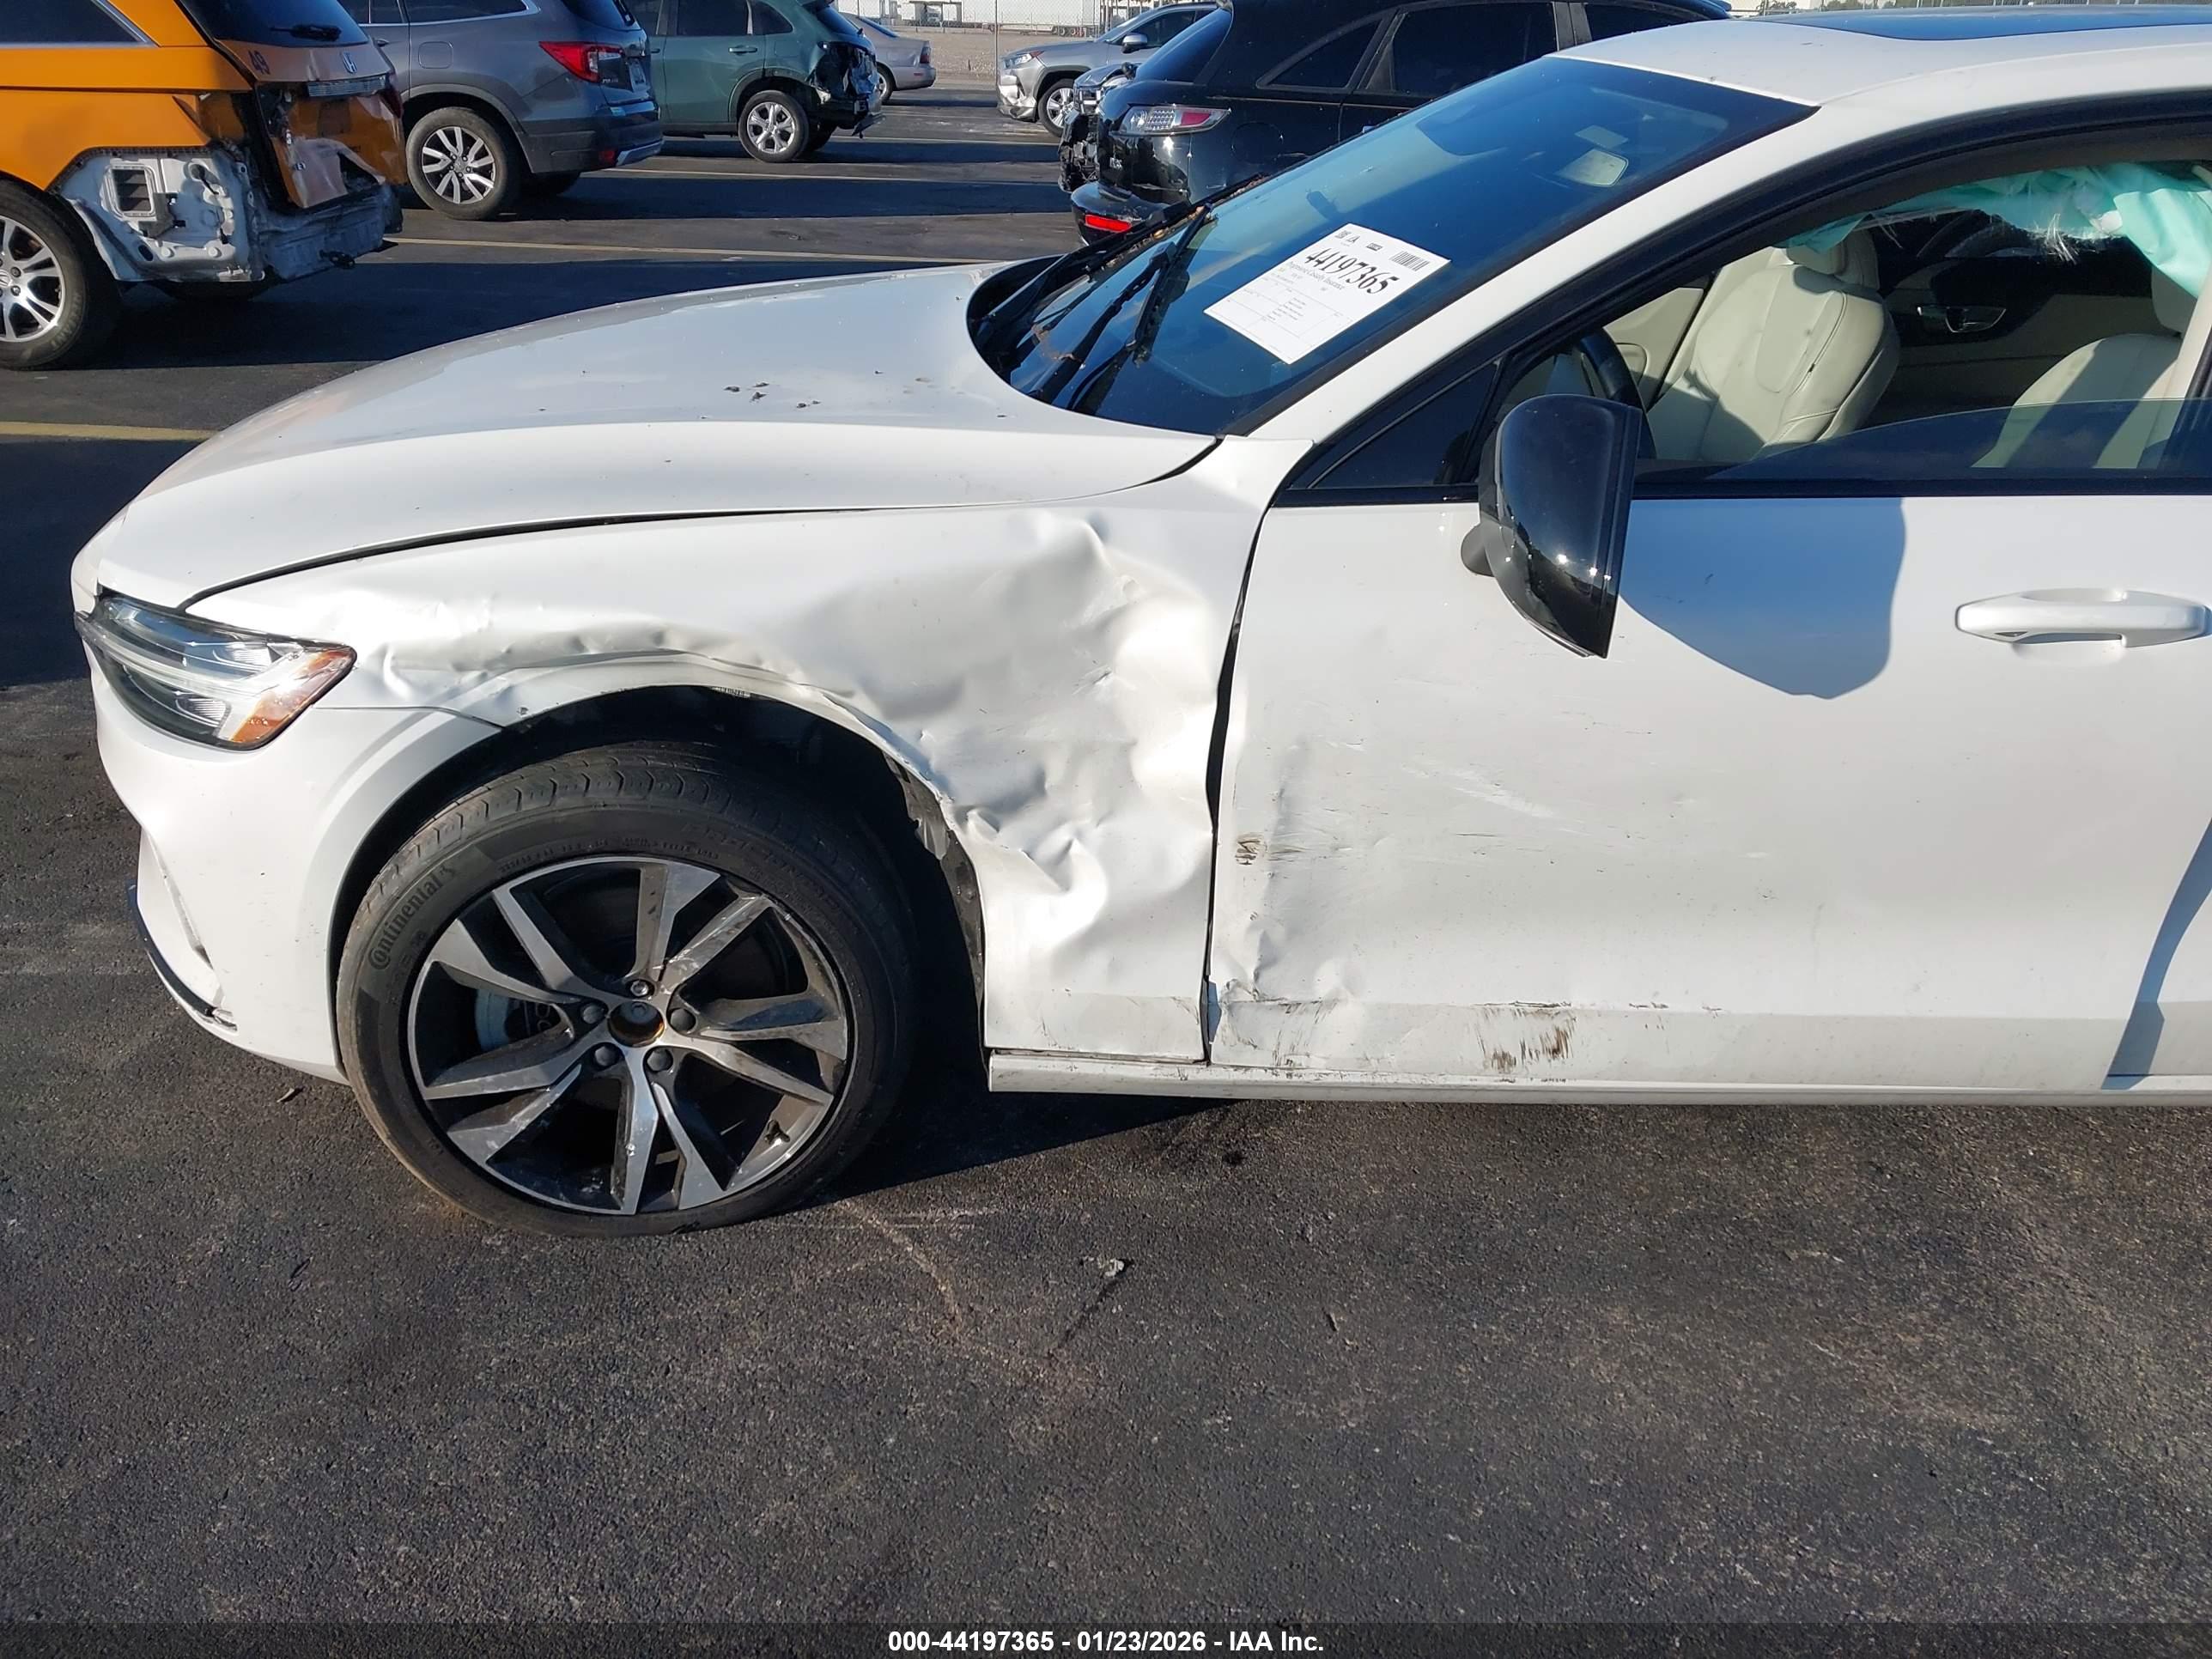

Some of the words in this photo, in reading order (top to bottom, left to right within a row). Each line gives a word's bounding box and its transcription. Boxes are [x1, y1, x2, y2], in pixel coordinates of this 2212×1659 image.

[247, 50, 270, 75] 49
[1304, 246, 1400, 294] 44197365
[368, 873, 444, 969] Continental
